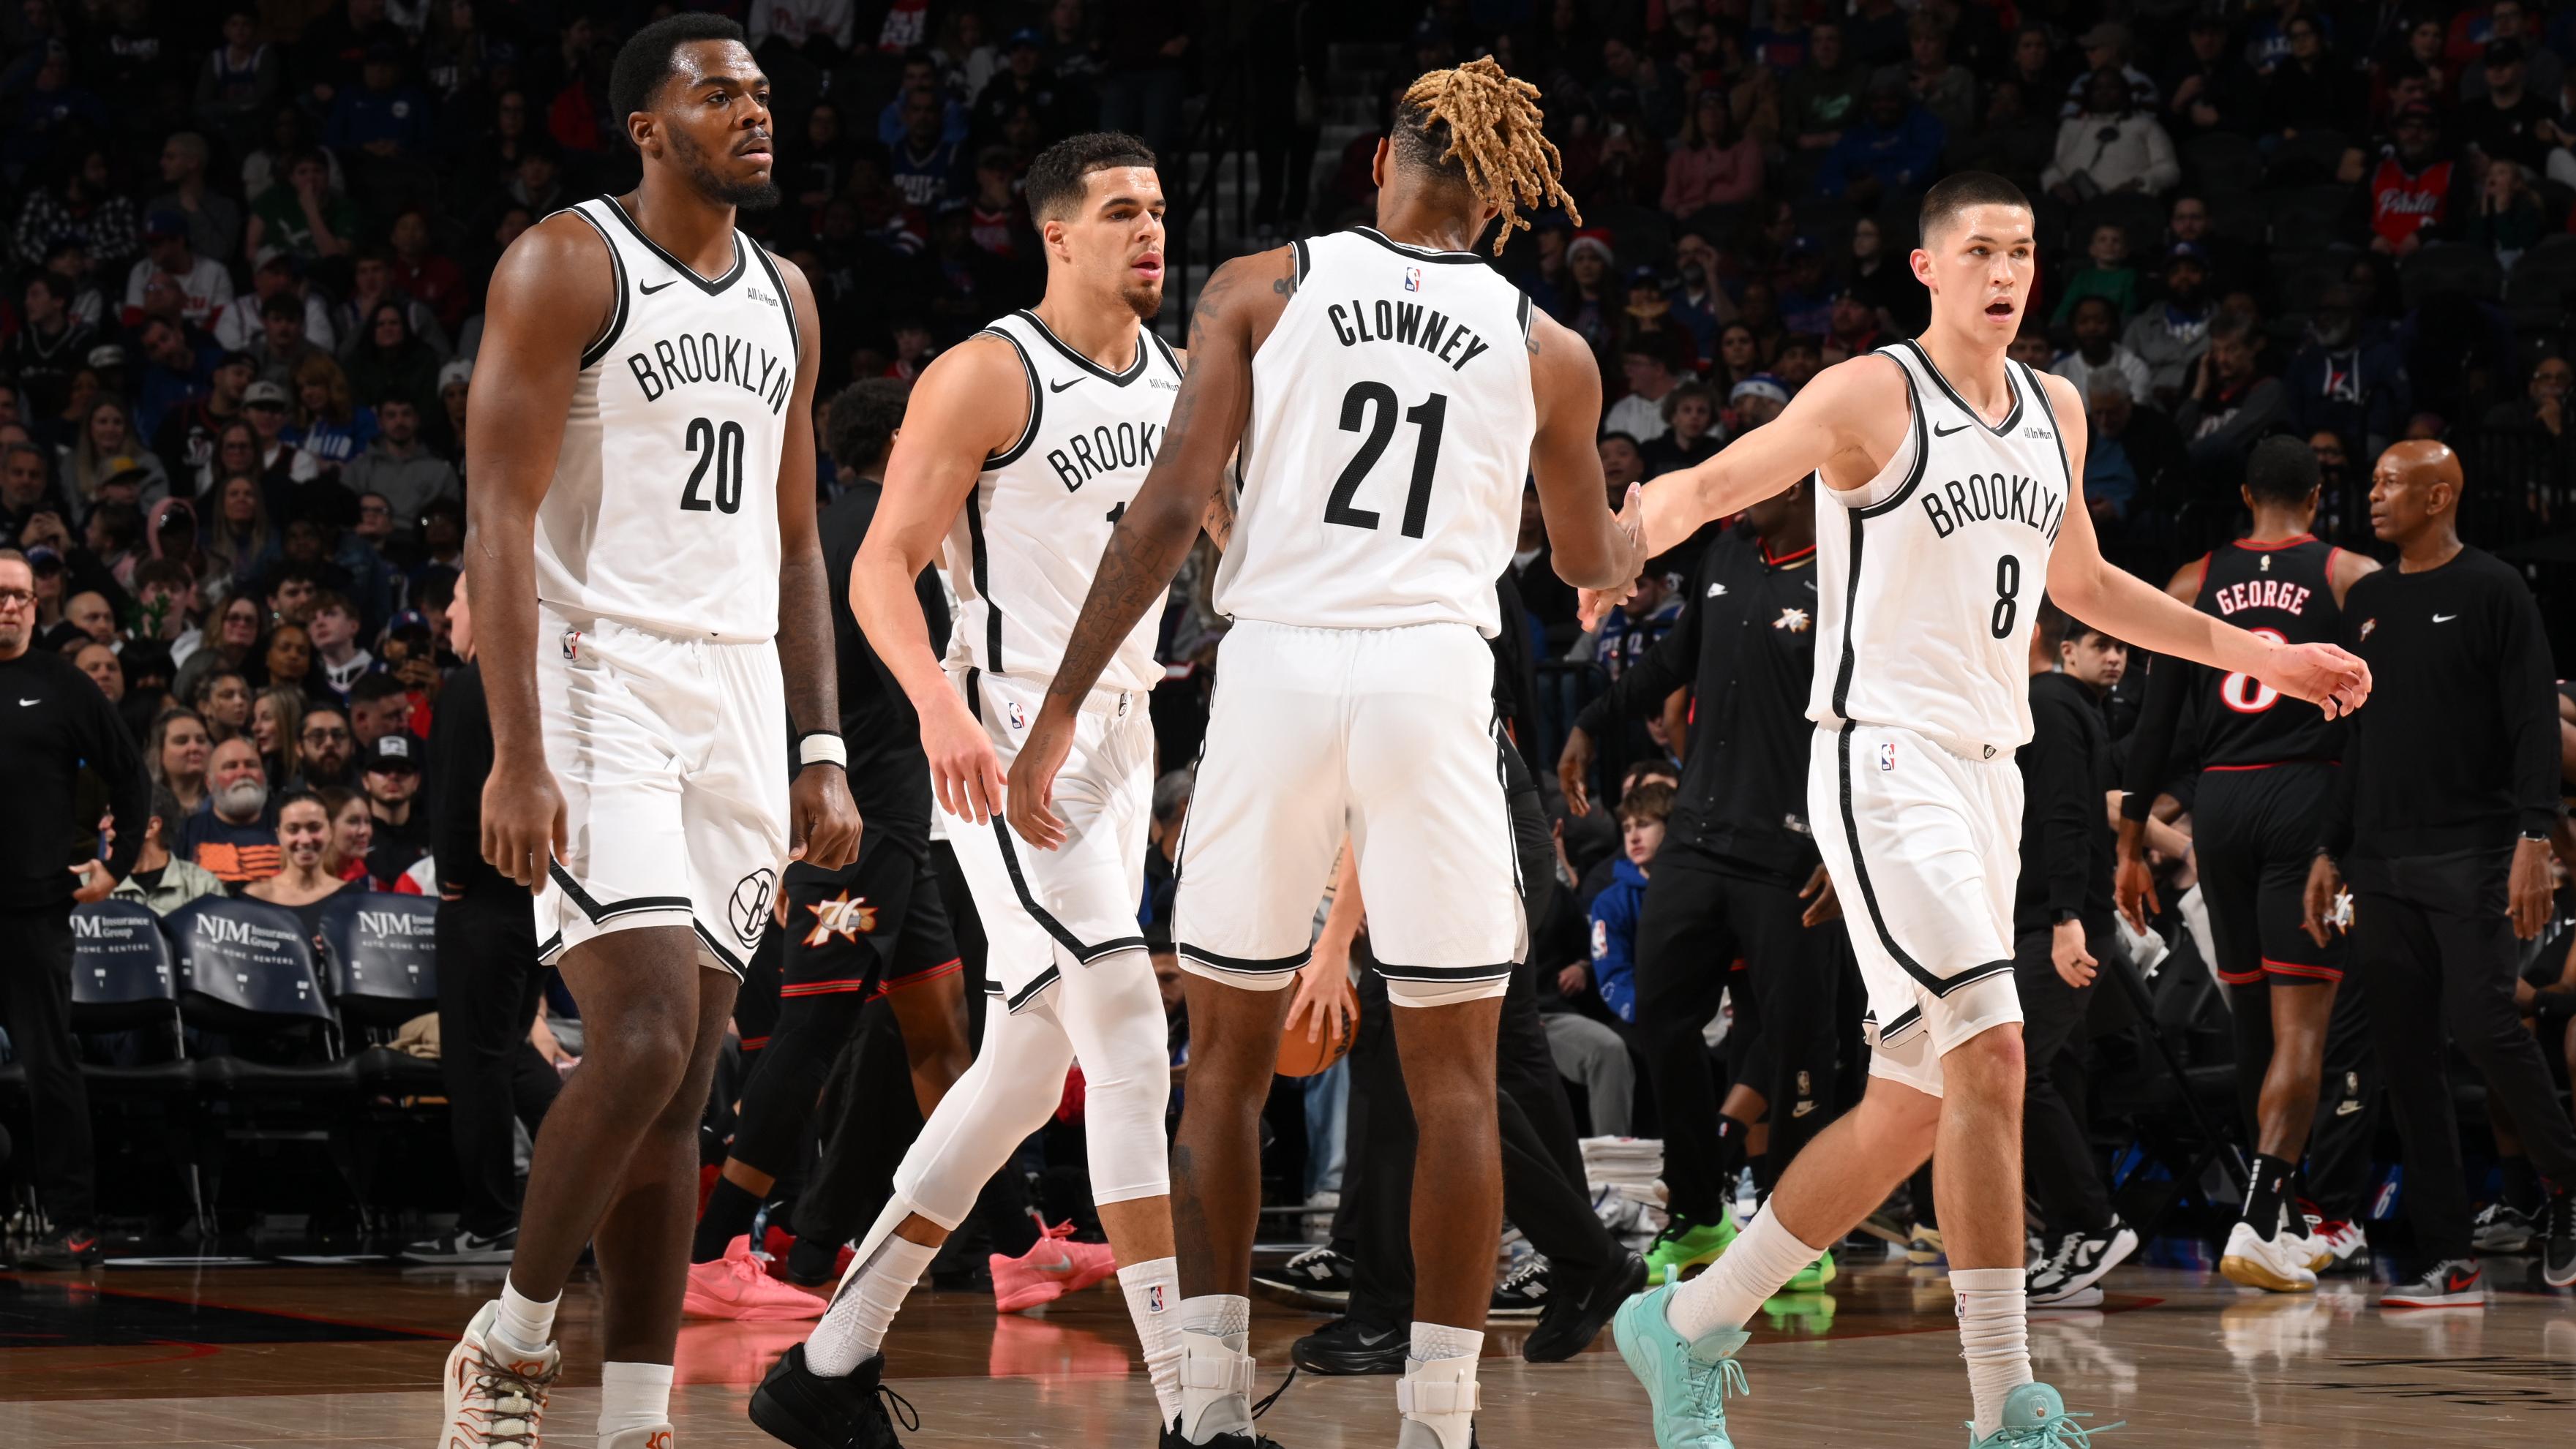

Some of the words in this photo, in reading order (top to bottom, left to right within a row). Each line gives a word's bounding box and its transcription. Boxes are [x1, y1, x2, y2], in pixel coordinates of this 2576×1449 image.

[1327, 299, 1489, 372] CLOWNEY
[627, 332, 791, 415] BROOKLYN
[2031, 427, 2038, 439] In
[2039, 427, 2053, 440] Won
[680, 417, 745, 514] 20
[1047, 421, 1165, 493] BROOK
[1323, 380, 1447, 539] 21
[1921, 473, 2064, 548] BROOKLYN
[1991, 554, 2020, 639] 8
[2215, 579, 2310, 615] GEORGE
[102, 916, 149, 926] Insurance
[102, 928, 133, 939] Group
[195, 912, 250, 944] NJM
[251, 924, 298, 942] Insurance
[357, 911, 413, 939] NJM
[812, 897, 866, 946] 76
[250, 936, 280, 952] Group
